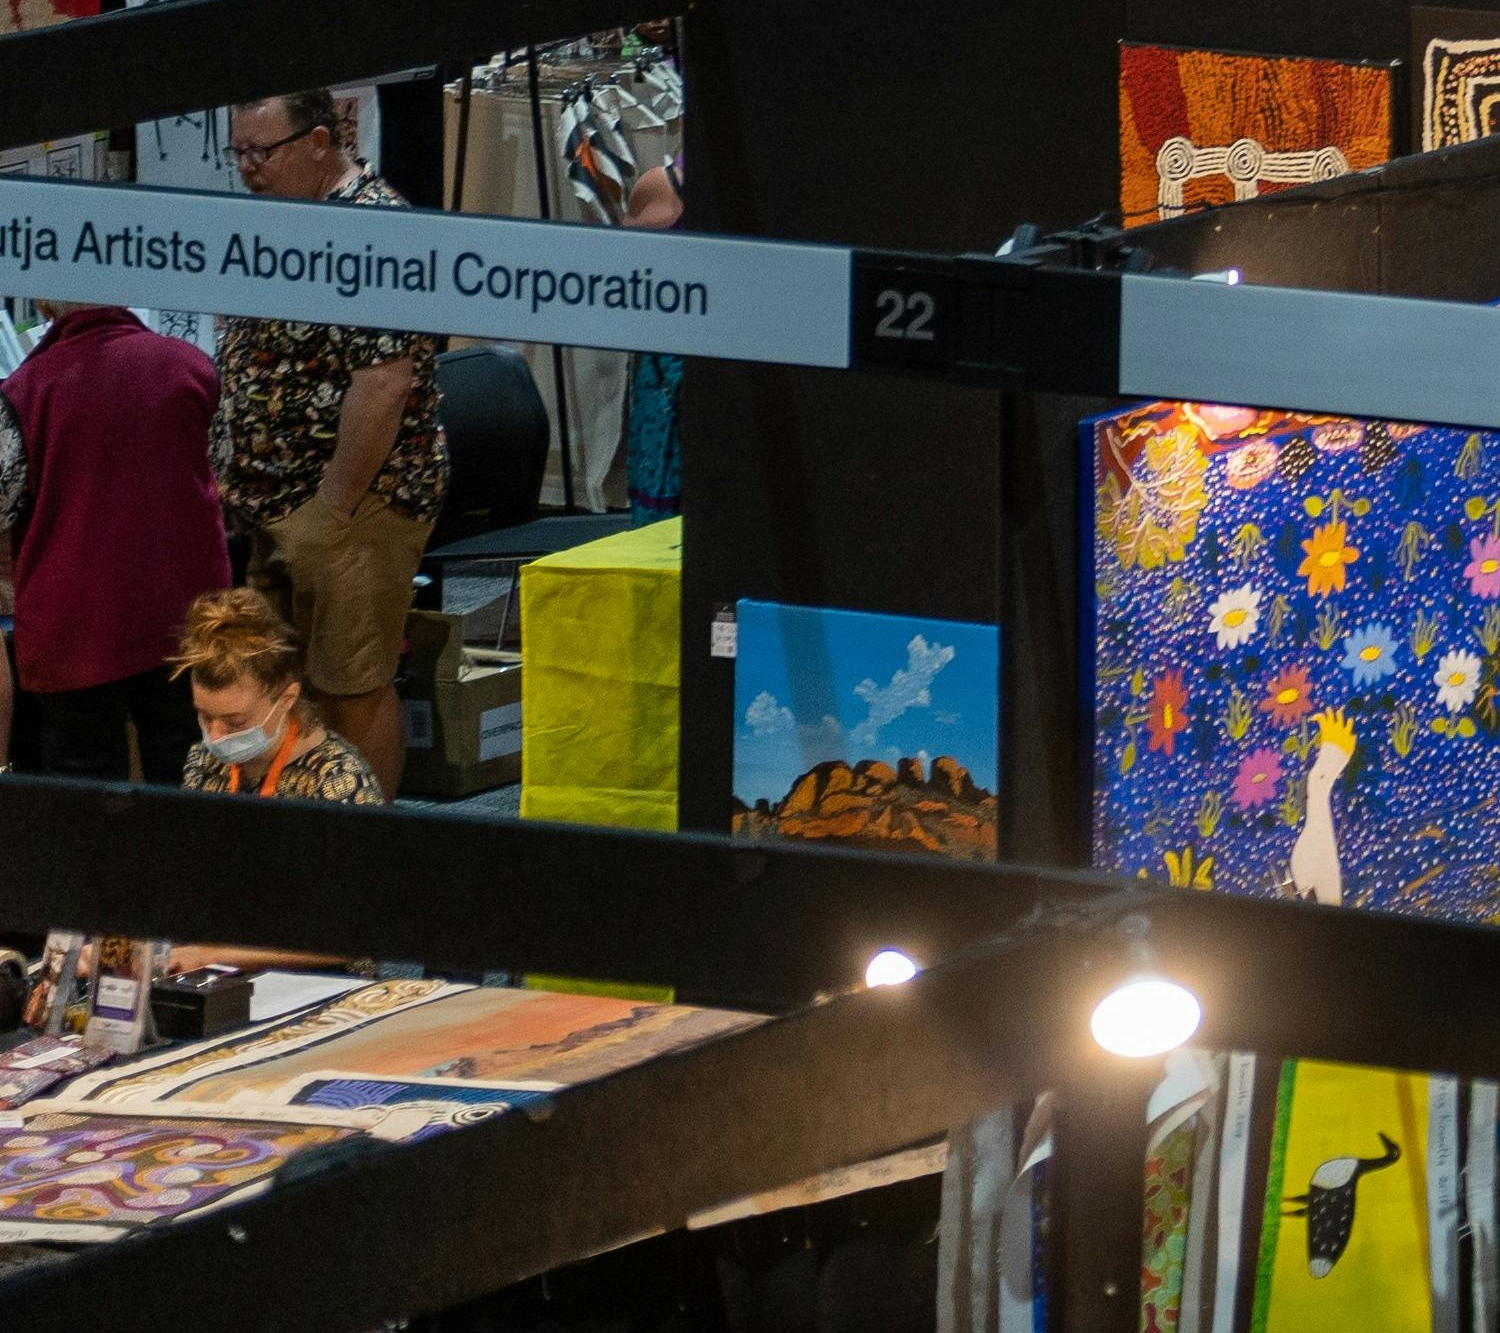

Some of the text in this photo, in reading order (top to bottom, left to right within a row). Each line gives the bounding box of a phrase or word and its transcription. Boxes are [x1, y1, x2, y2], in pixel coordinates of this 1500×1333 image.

[71, 220, 207, 274] Artists
[218, 232, 438, 298] Aboriginal
[452, 251, 708, 317] Corporation
[874, 290, 936, 342] 22
